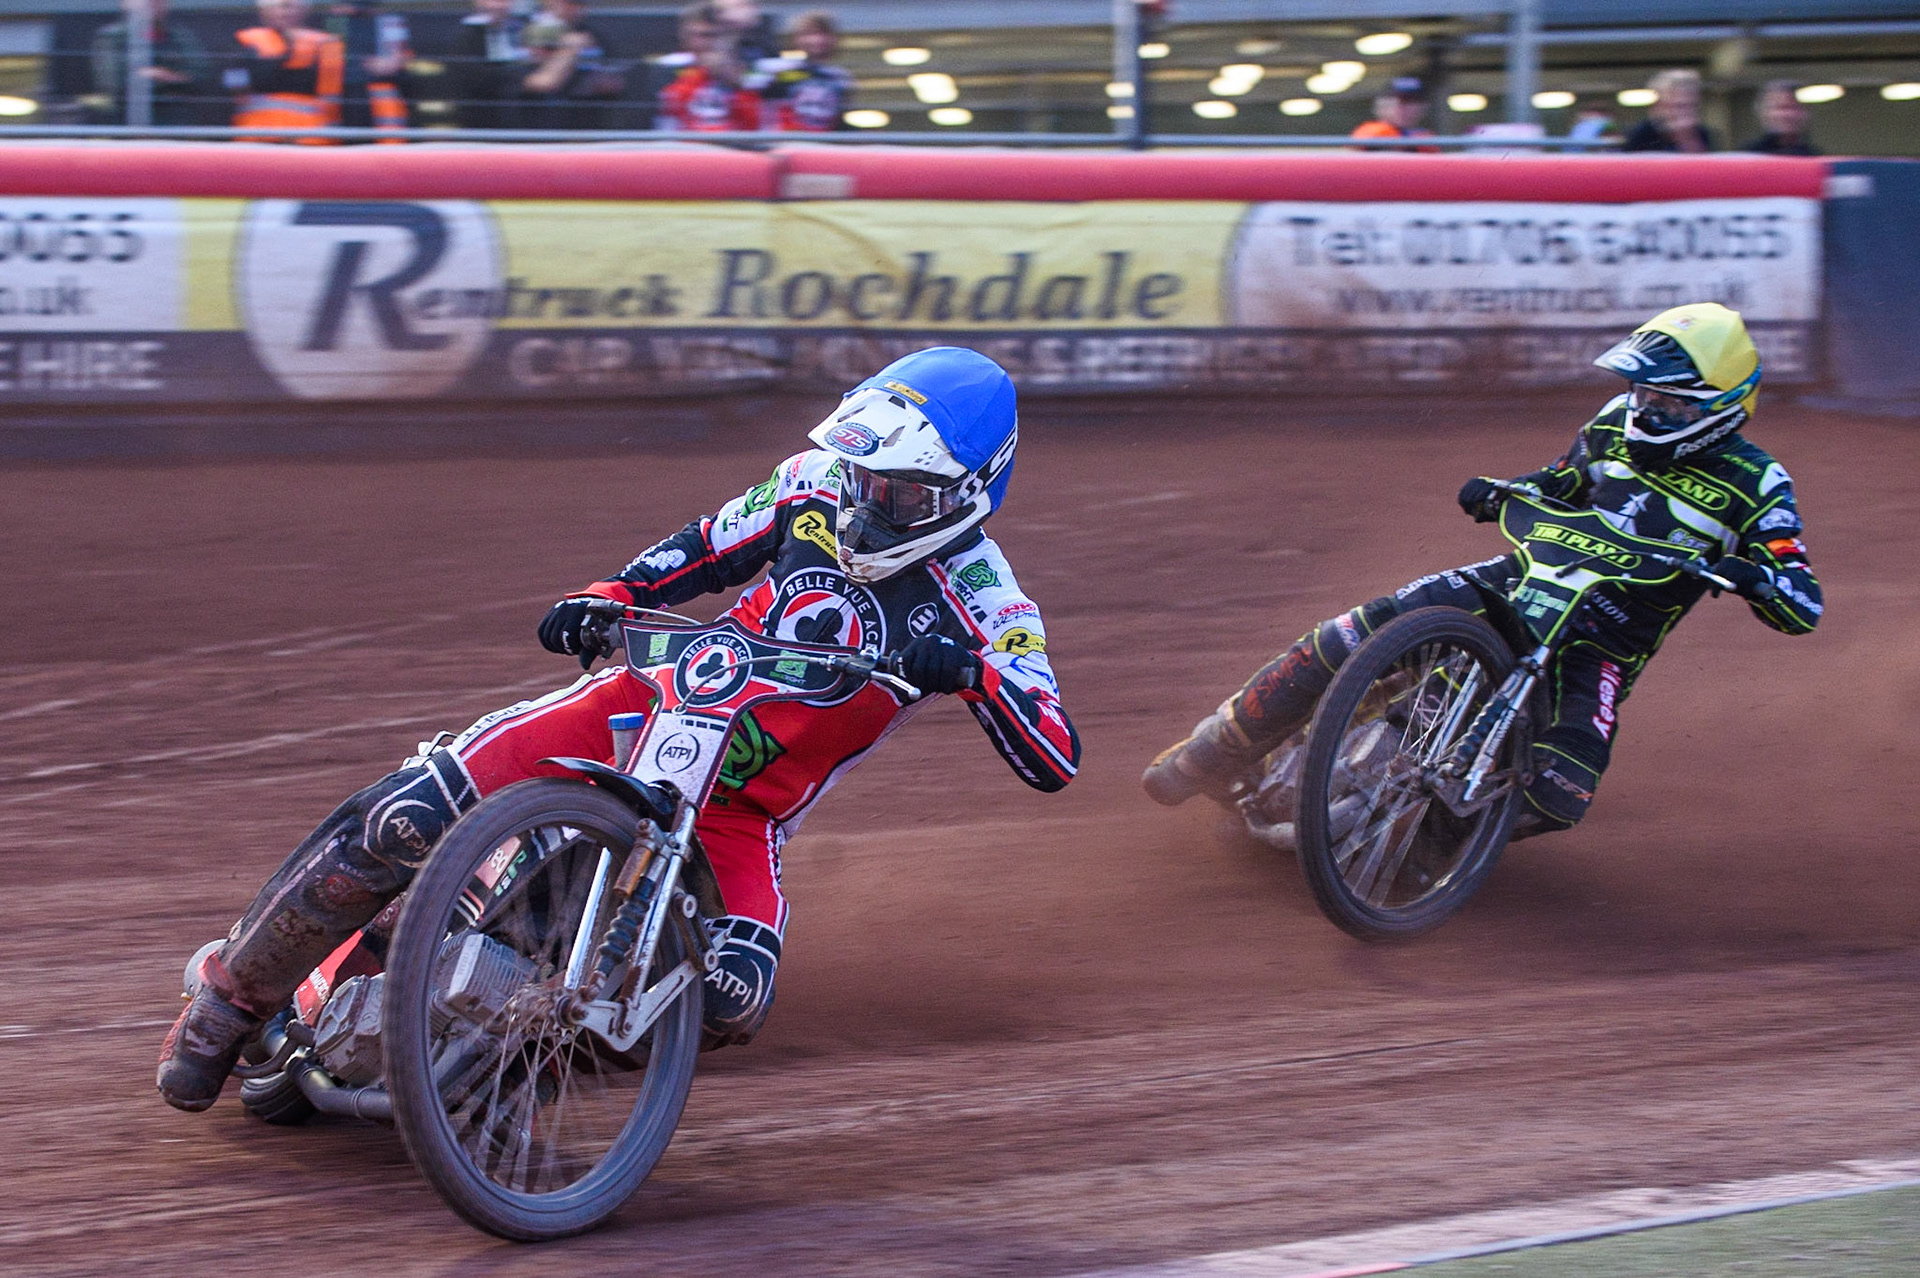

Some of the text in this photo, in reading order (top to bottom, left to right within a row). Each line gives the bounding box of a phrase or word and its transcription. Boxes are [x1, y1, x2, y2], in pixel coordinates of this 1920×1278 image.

[703, 247, 1188, 322] Rochdale
[831, 427, 871, 449] STS
[1662, 472, 1723, 504] LANT
[785, 575, 879, 651] BELLE VUE ACE
[684, 637, 713, 660] BELLE
[716, 636, 737, 647] VUE
[734, 645, 748, 661] ACE
[661, 745, 693, 760] ATPI
[389, 816, 431, 857] ATPI
[704, 967, 752, 1006] ATPI
